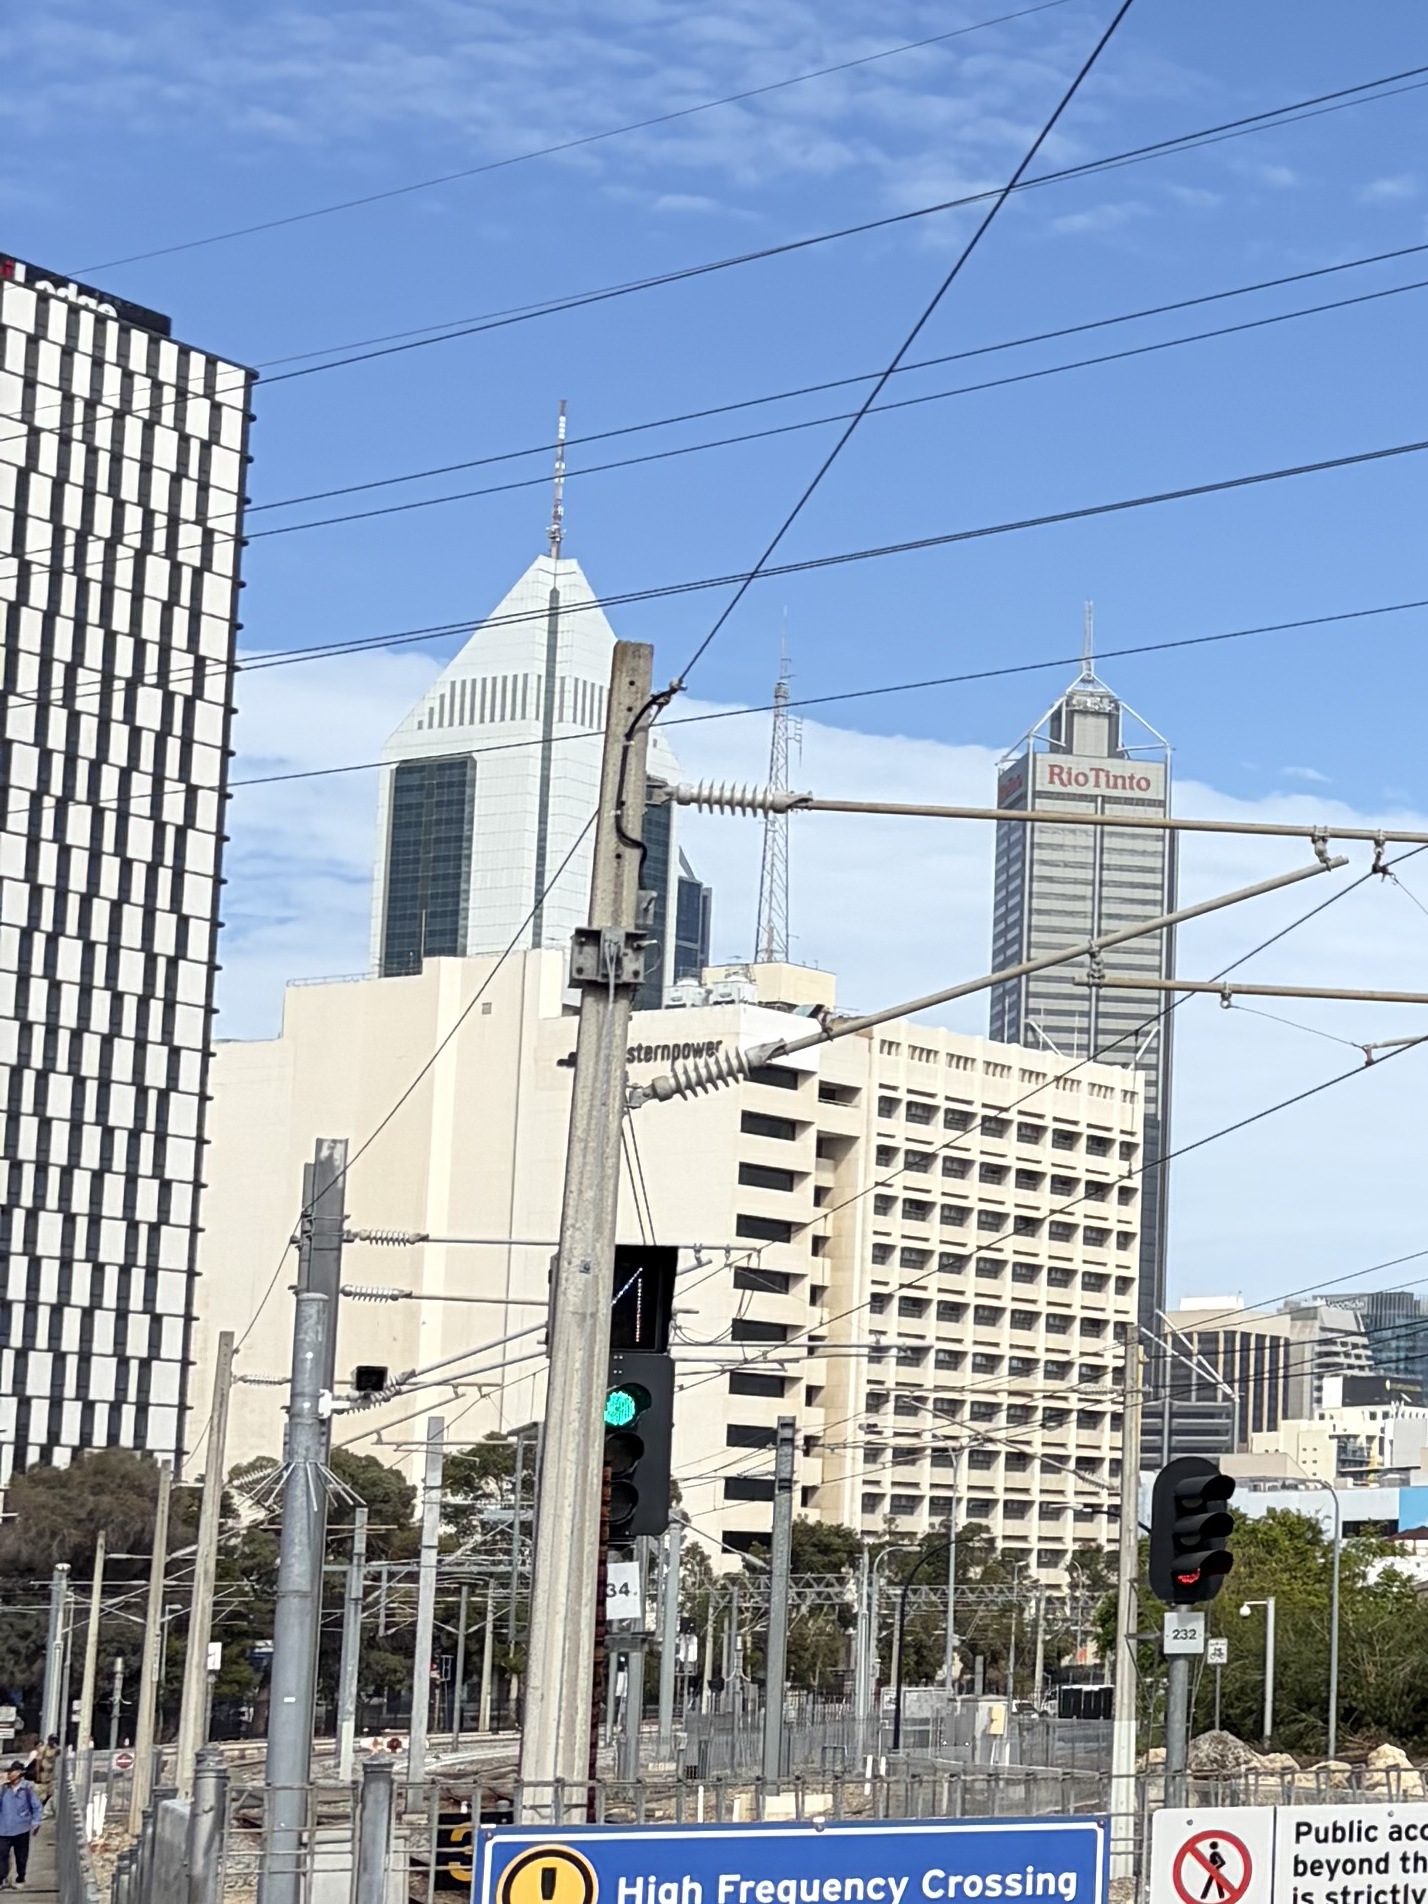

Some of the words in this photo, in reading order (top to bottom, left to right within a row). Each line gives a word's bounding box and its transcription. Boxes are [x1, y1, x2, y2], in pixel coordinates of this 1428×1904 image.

[627, 1040, 723, 1068] sternpower
[1173, 1629, 1196, 1640] 232
[1296, 1820, 1378, 1844] Public
[1294, 1852, 1389, 1881] beyond
[922, 1866, 1076, 1901] Crossing
